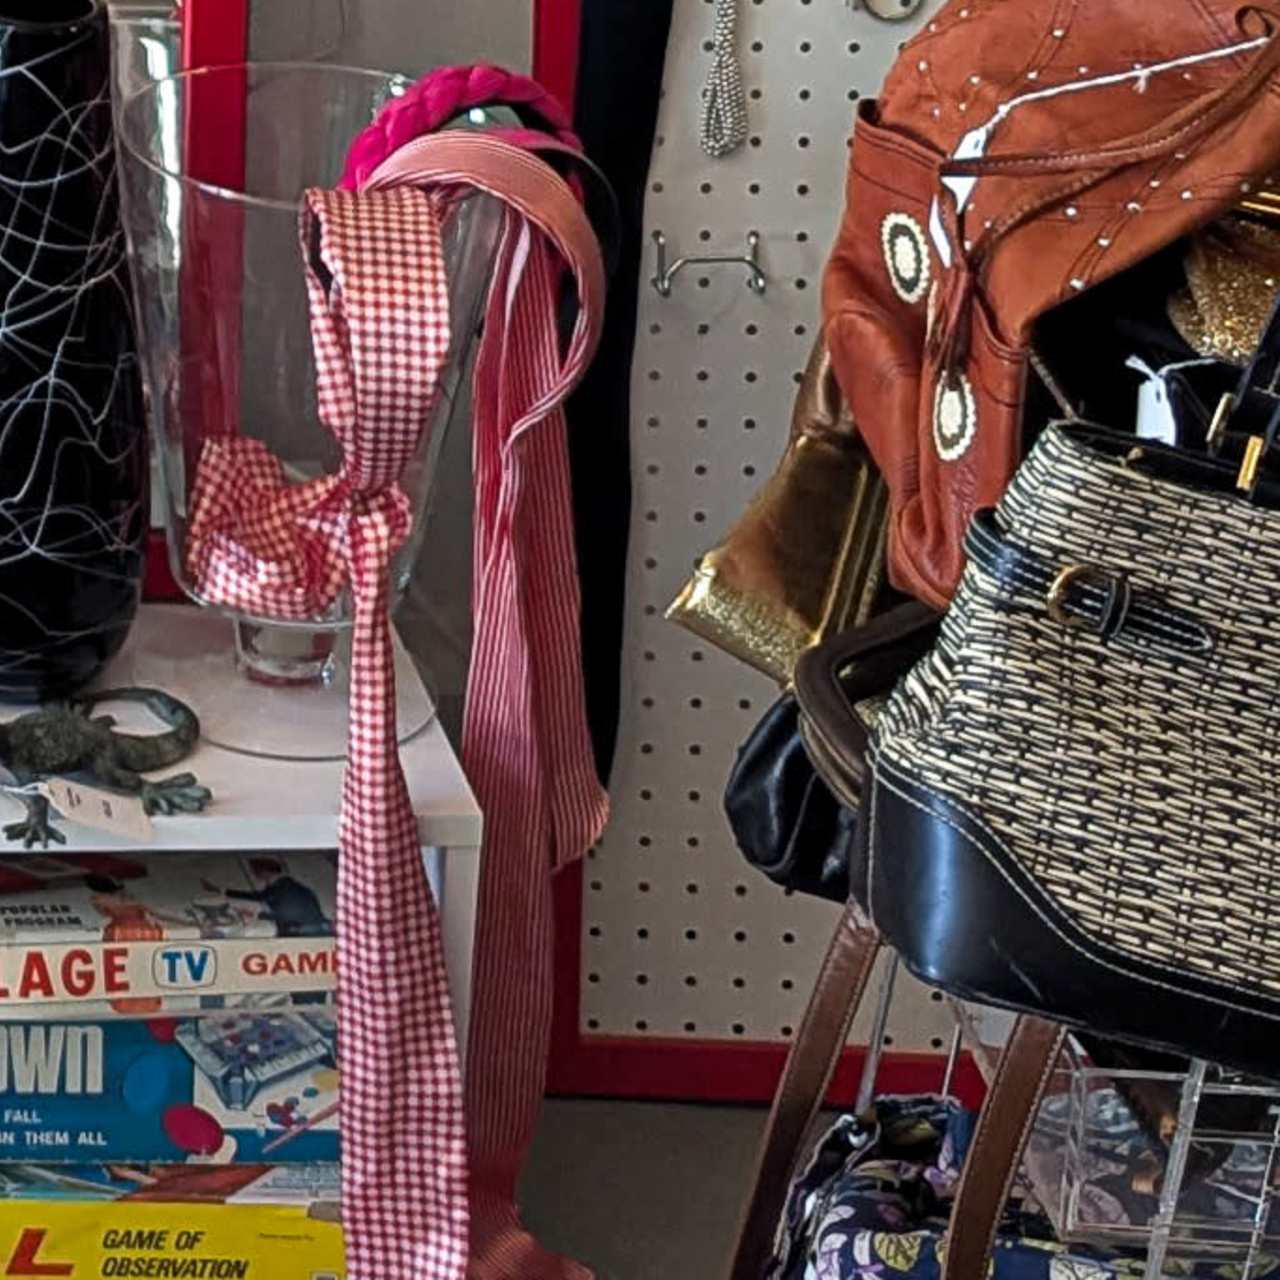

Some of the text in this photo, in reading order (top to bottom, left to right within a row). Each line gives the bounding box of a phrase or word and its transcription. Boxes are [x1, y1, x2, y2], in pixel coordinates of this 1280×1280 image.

[0, 904, 72, 916] POPULAR
[4, 916, 82, 927] PROGRAM
[161, 950, 209, 983] TV
[4, 1108, 42, 1124] FALL
[24, 1129, 70, 1145] THEM
[77, 1129, 108, 1145] ALL
[101, 1229, 250, 1279] GAME OF OBSERVATION
